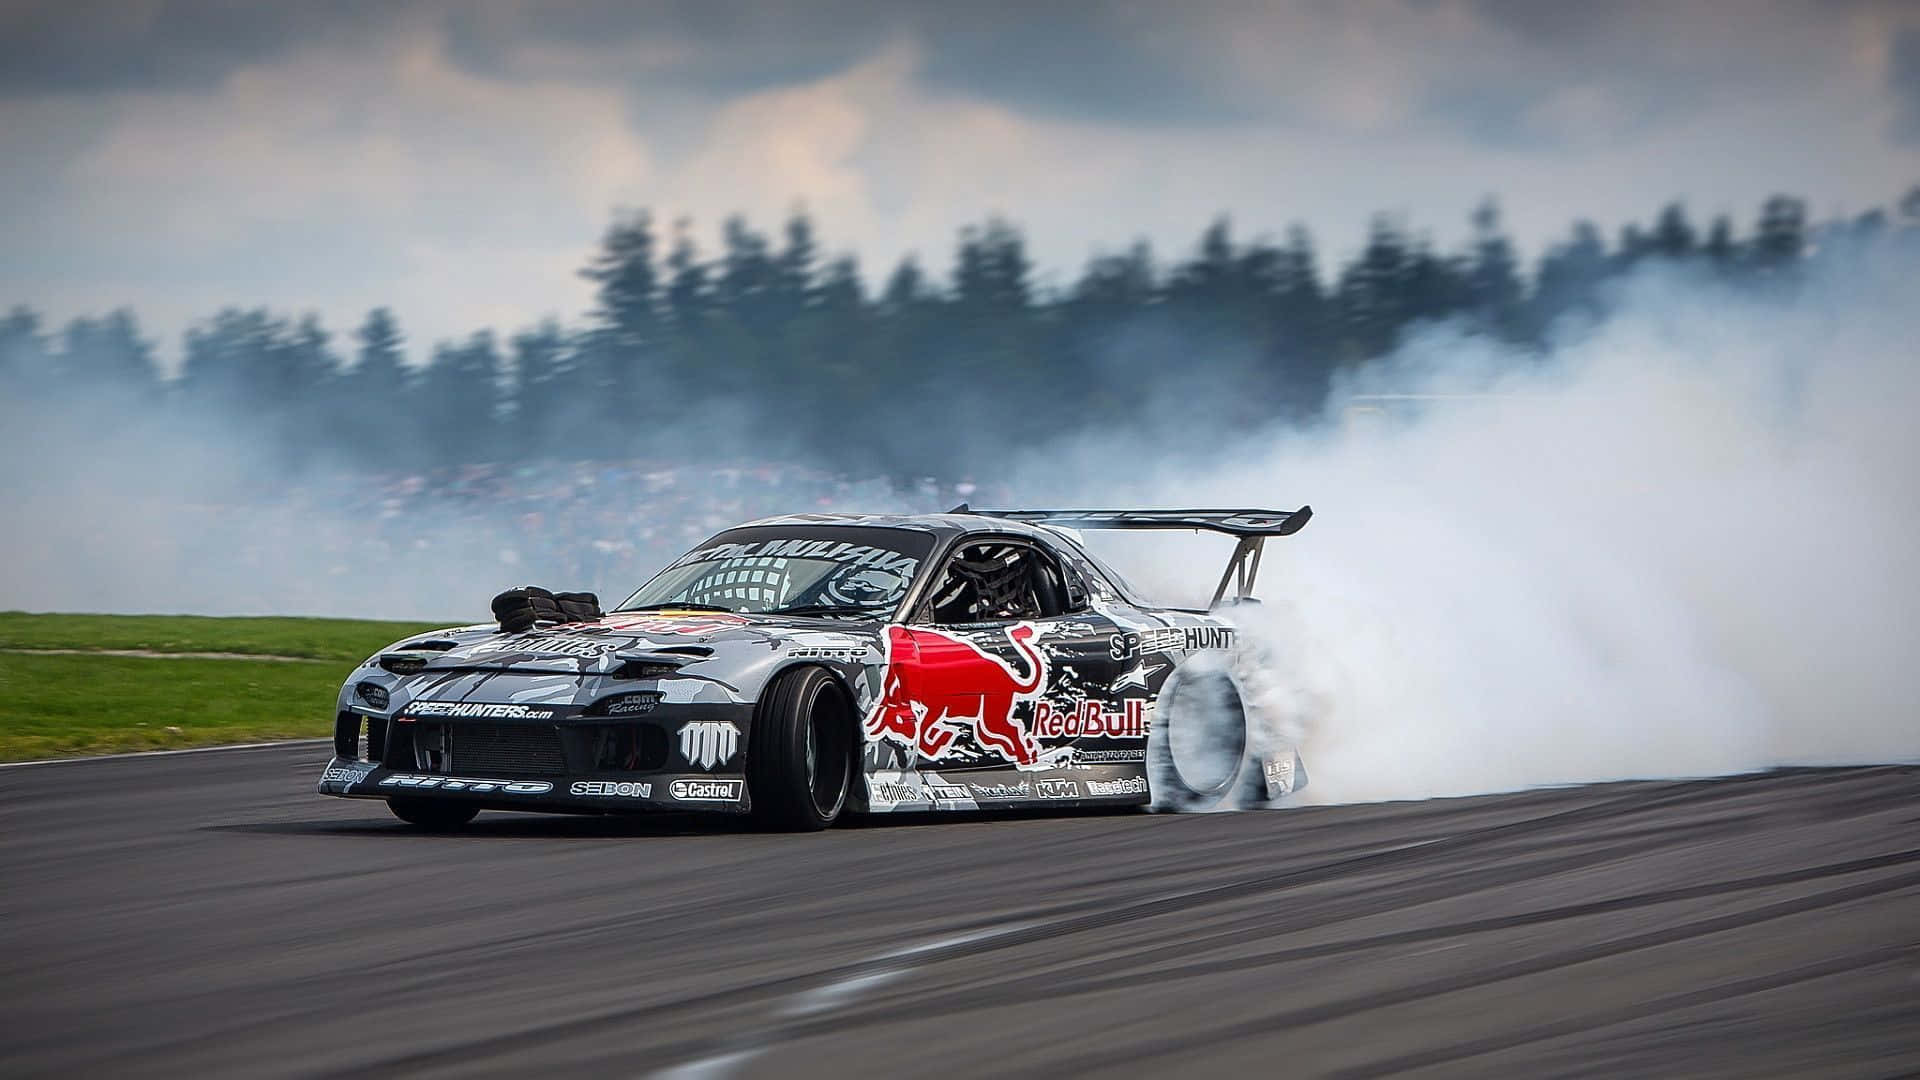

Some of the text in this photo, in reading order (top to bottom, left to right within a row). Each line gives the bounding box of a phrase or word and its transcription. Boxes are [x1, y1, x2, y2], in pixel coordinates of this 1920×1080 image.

[756, 539, 920, 579] MULISHA
[786, 646, 869, 659] NITTO
[608, 703, 655, 715] Racing
[1032, 699, 1143, 738] Red Bull
[379, 776, 554, 794] NITTO
[687, 782, 734, 798] Castrol
[1036, 779, 1079, 798] KTM
